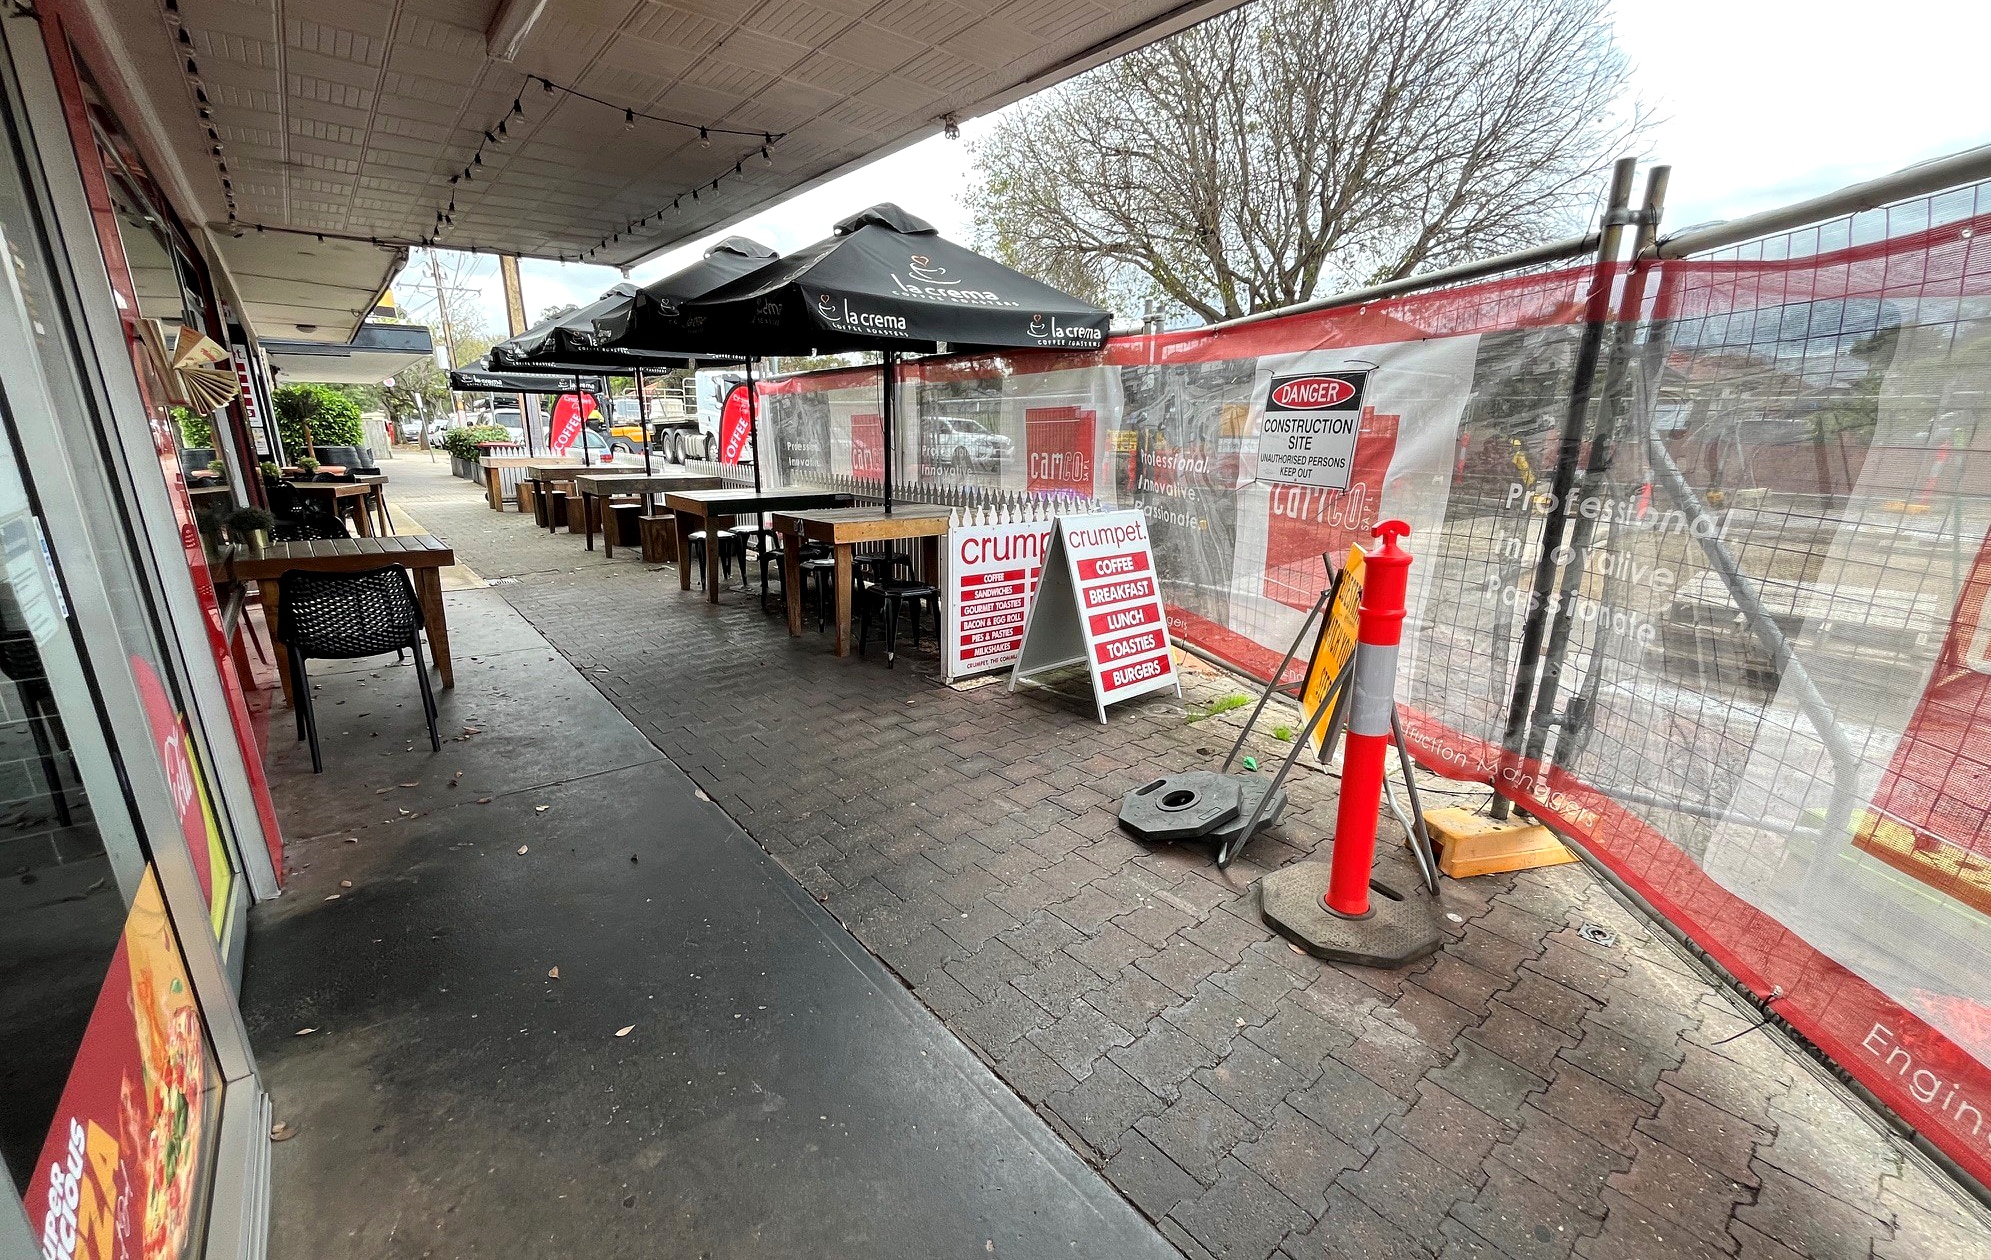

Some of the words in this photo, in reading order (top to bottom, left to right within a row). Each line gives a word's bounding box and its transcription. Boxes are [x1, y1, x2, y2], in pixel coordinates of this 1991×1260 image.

[924, 287, 999, 301] crema
[844, 297, 859, 325] la
[860, 313, 907, 330] crema
[1051, 316, 1065, 338] la
[1065, 326, 1102, 340] crema
[1281, 382, 1340, 404] DANGER
[1264, 418, 1354, 435] CONSTRUCTION
[1288, 435, 1313, 450] SITE
[1260, 453, 1307, 466] UNAUTHORISED
[1307, 456, 1346, 469] PERSONS
[1279, 466, 1297, 477] KEEP
[1298, 468, 1313, 479] OUT
[1069, 520, 1147, 549] crumpet.
[1095, 556, 1135, 575] COFFEE
[983, 572, 1005, 583] COFFEE
[974, 585, 1013, 599] SANDWICHES
[1088, 580, 1150, 605] BREAKFAST
[963, 602, 995, 615] GOURMET
[995, 598, 1022, 611] TOASTIES
[963, 618, 986, 631] BACON
[986, 616, 992, 627] &
[993, 613, 1006, 626] EGG
[1006, 612, 1022, 623] ROLL
[1107, 608, 1145, 630] LUNCH
[971, 632, 985, 644] PIES
[985, 630, 991, 641] &
[991, 626, 1014, 639] PASTIES
[973, 641, 1011, 657] MILKSHAKES
[1106, 633, 1156, 659] TOASTIES
[1112, 660, 1161, 686] BURGERS
[1861, 1021, 1991, 1149] Engin
